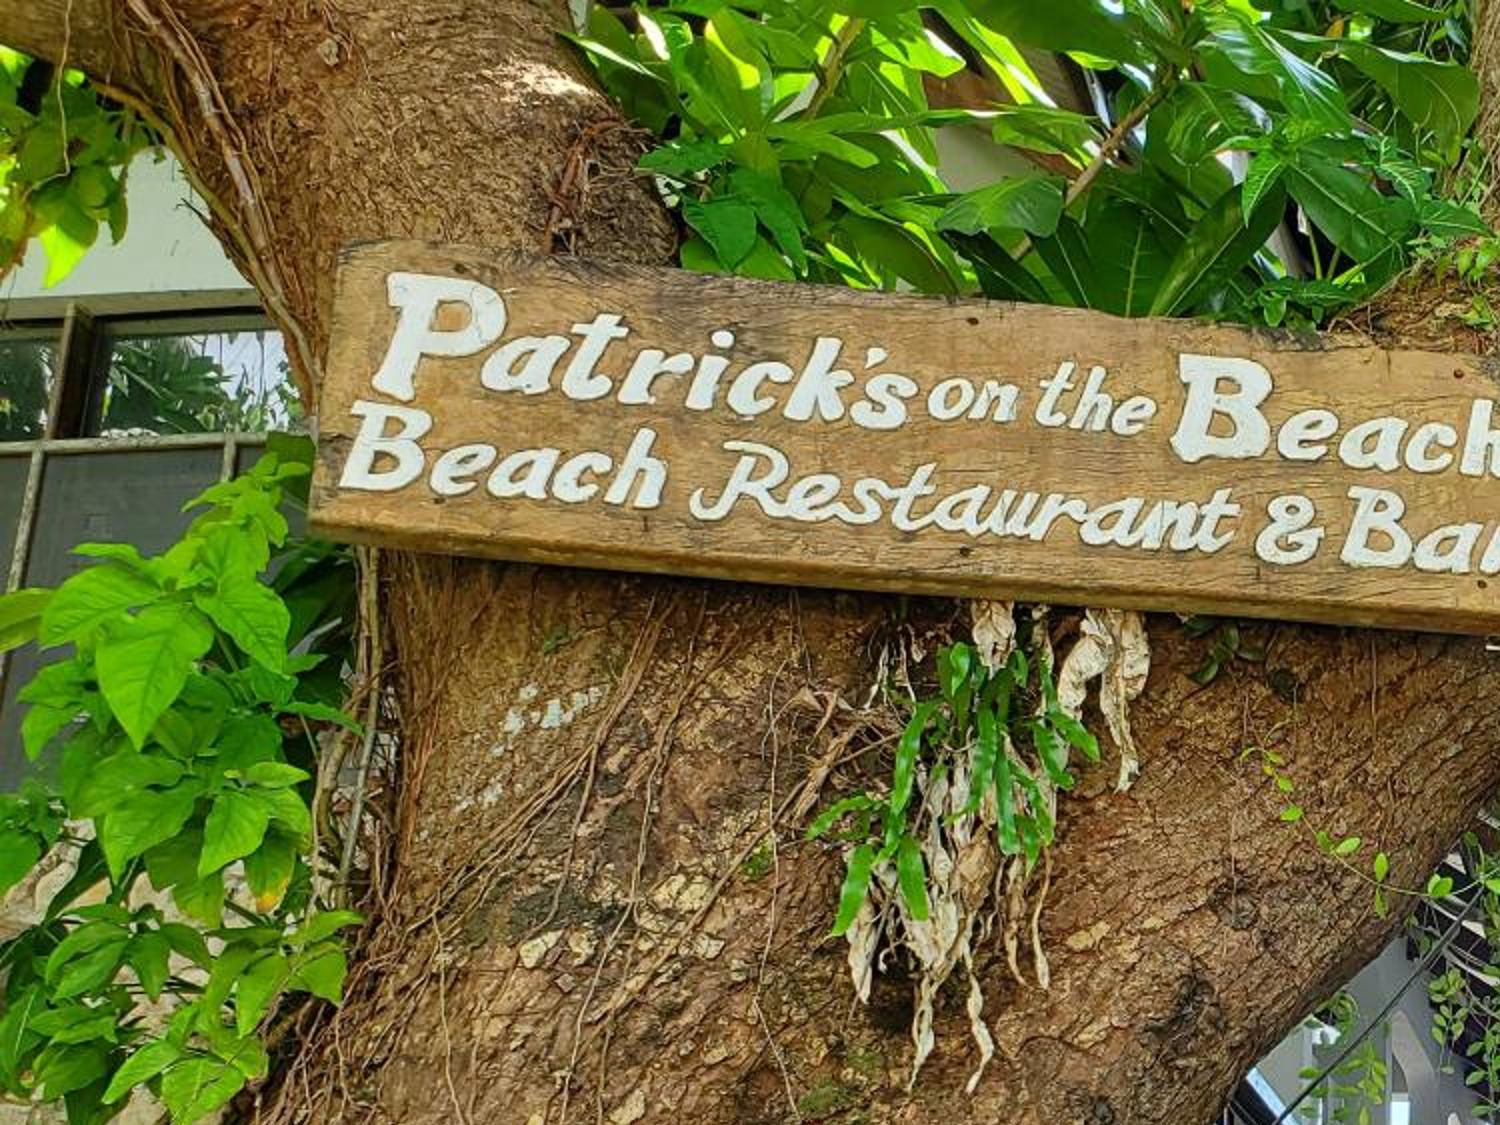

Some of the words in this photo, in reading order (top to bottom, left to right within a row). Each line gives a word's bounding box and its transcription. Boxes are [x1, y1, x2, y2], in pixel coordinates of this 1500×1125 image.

[371, 272, 918, 430] Patrick's
[926, 377, 1019, 422] on
[1034, 361, 1157, 436] the
[339, 400, 667, 509] Beach
[690, 440, 1240, 554] Restaurant
[1255, 495, 1325, 565] &
